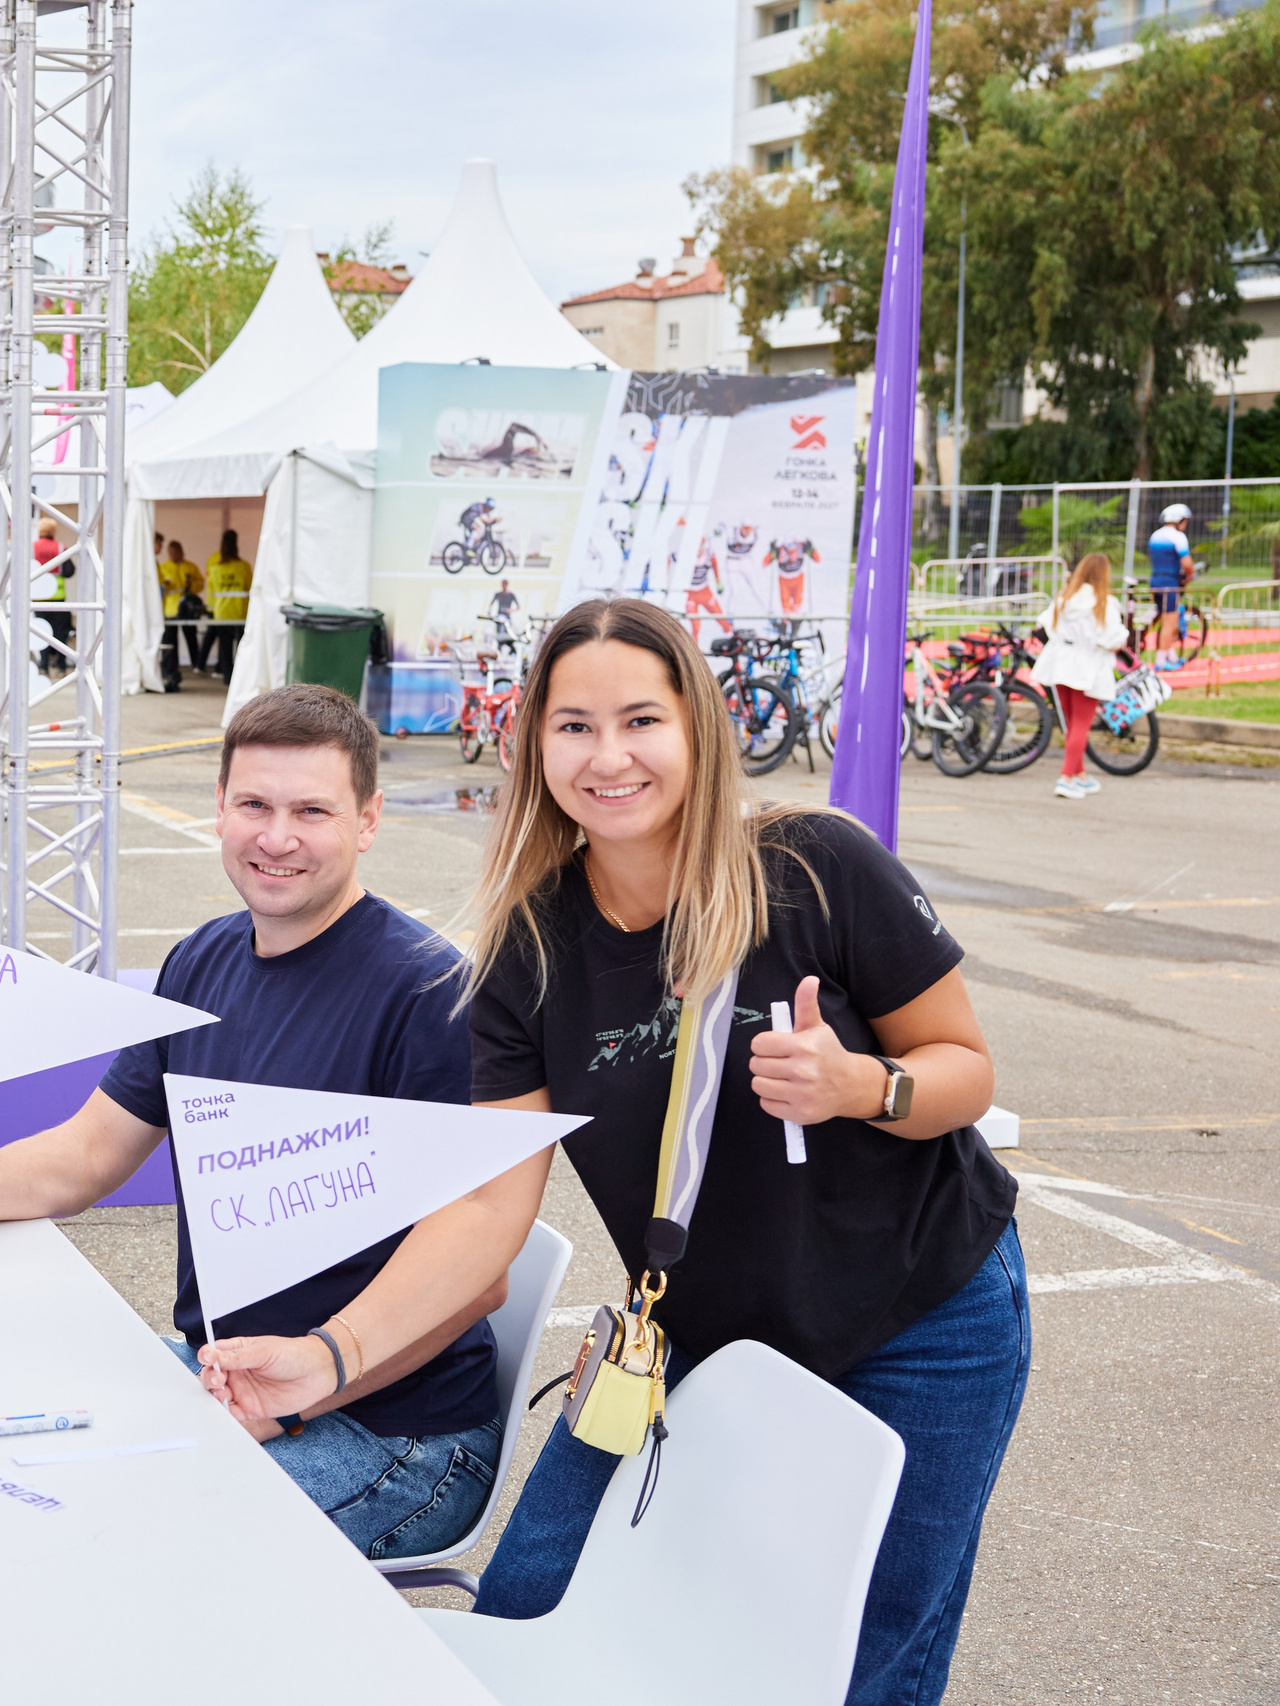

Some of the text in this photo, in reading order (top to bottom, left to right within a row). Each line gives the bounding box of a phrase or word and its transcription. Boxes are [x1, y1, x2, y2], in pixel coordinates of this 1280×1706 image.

[599, 411, 731, 503] SKI
[785, 457, 827, 467] ГОНКА
[578, 503, 708, 593] SKI
[659, 1050, 676, 1059] NORT
[181, 1092, 235, 1109] точка
[184, 1106, 230, 1124] банк
[197, 1116, 371, 1175] ПОДНАЖМИ!
[210, 1193, 257, 1233] СК
[1, 1482, 61, 1511] ЦЕЛЬ
